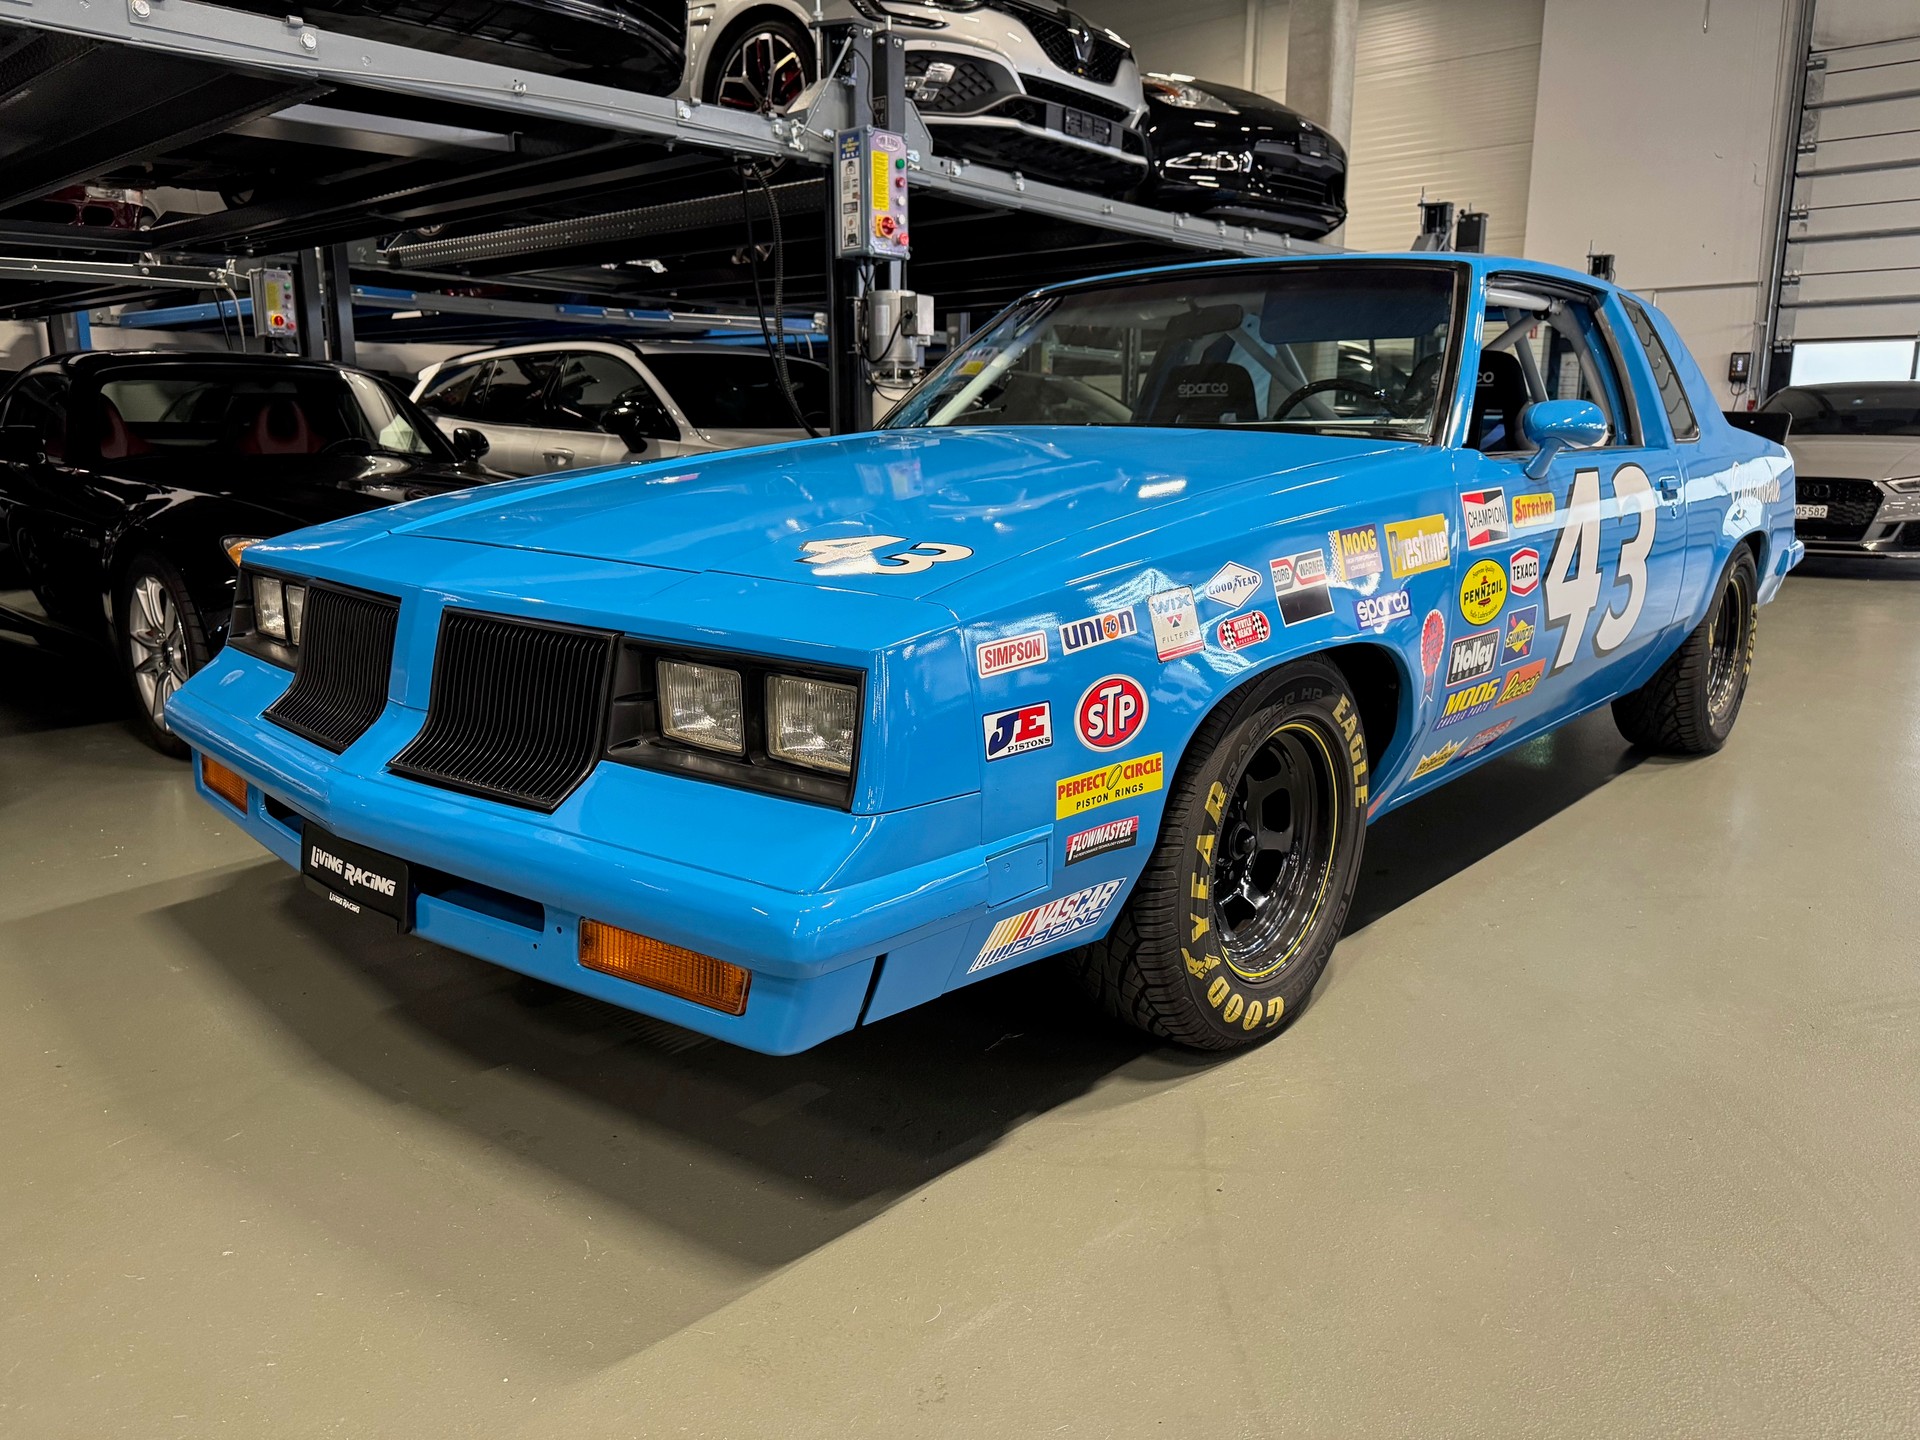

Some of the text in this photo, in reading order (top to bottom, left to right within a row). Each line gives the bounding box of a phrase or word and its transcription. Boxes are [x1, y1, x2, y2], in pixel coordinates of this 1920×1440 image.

[1178, 382, 1229, 398] sparco
[1468, 506, 1506, 529] CHAMPION
[795, 534, 975, 575] 43
[1342, 529, 1377, 556] MOOG
[1388, 529, 1448, 573] Prestone
[1273, 559, 1325, 583] BORG WARNER
[1513, 561, 1538, 581] TEXACO
[1542, 463, 1656, 676] 43
[1151, 593, 1192, 615] WIX
[1357, 590, 1409, 625] sparco
[1464, 579, 1503, 605] PENNZOIL
[1105, 620, 1117, 633] 76
[1162, 629, 1194, 644] FILTERS
[1506, 626, 1534, 645] SUNOCO
[984, 638, 1041, 669] SIMPSON
[1452, 640, 1495, 673] Holley
[1087, 684, 1137, 738] STP
[1441, 678, 1501, 718] MOOG
[988, 705, 1046, 756] JE
[1007, 736, 1051, 754] PISTONS
[1332, 693, 1368, 808] EAGLE
[1058, 757, 1162, 800] PERFECT CIRCLE
[1076, 782, 1144, 810] PISTON RINGS
[1068, 819, 1133, 861] FLOWMASTER
[1025, 880, 1121, 935] NASCAR
[1008, 908, 1103, 955] RACING
